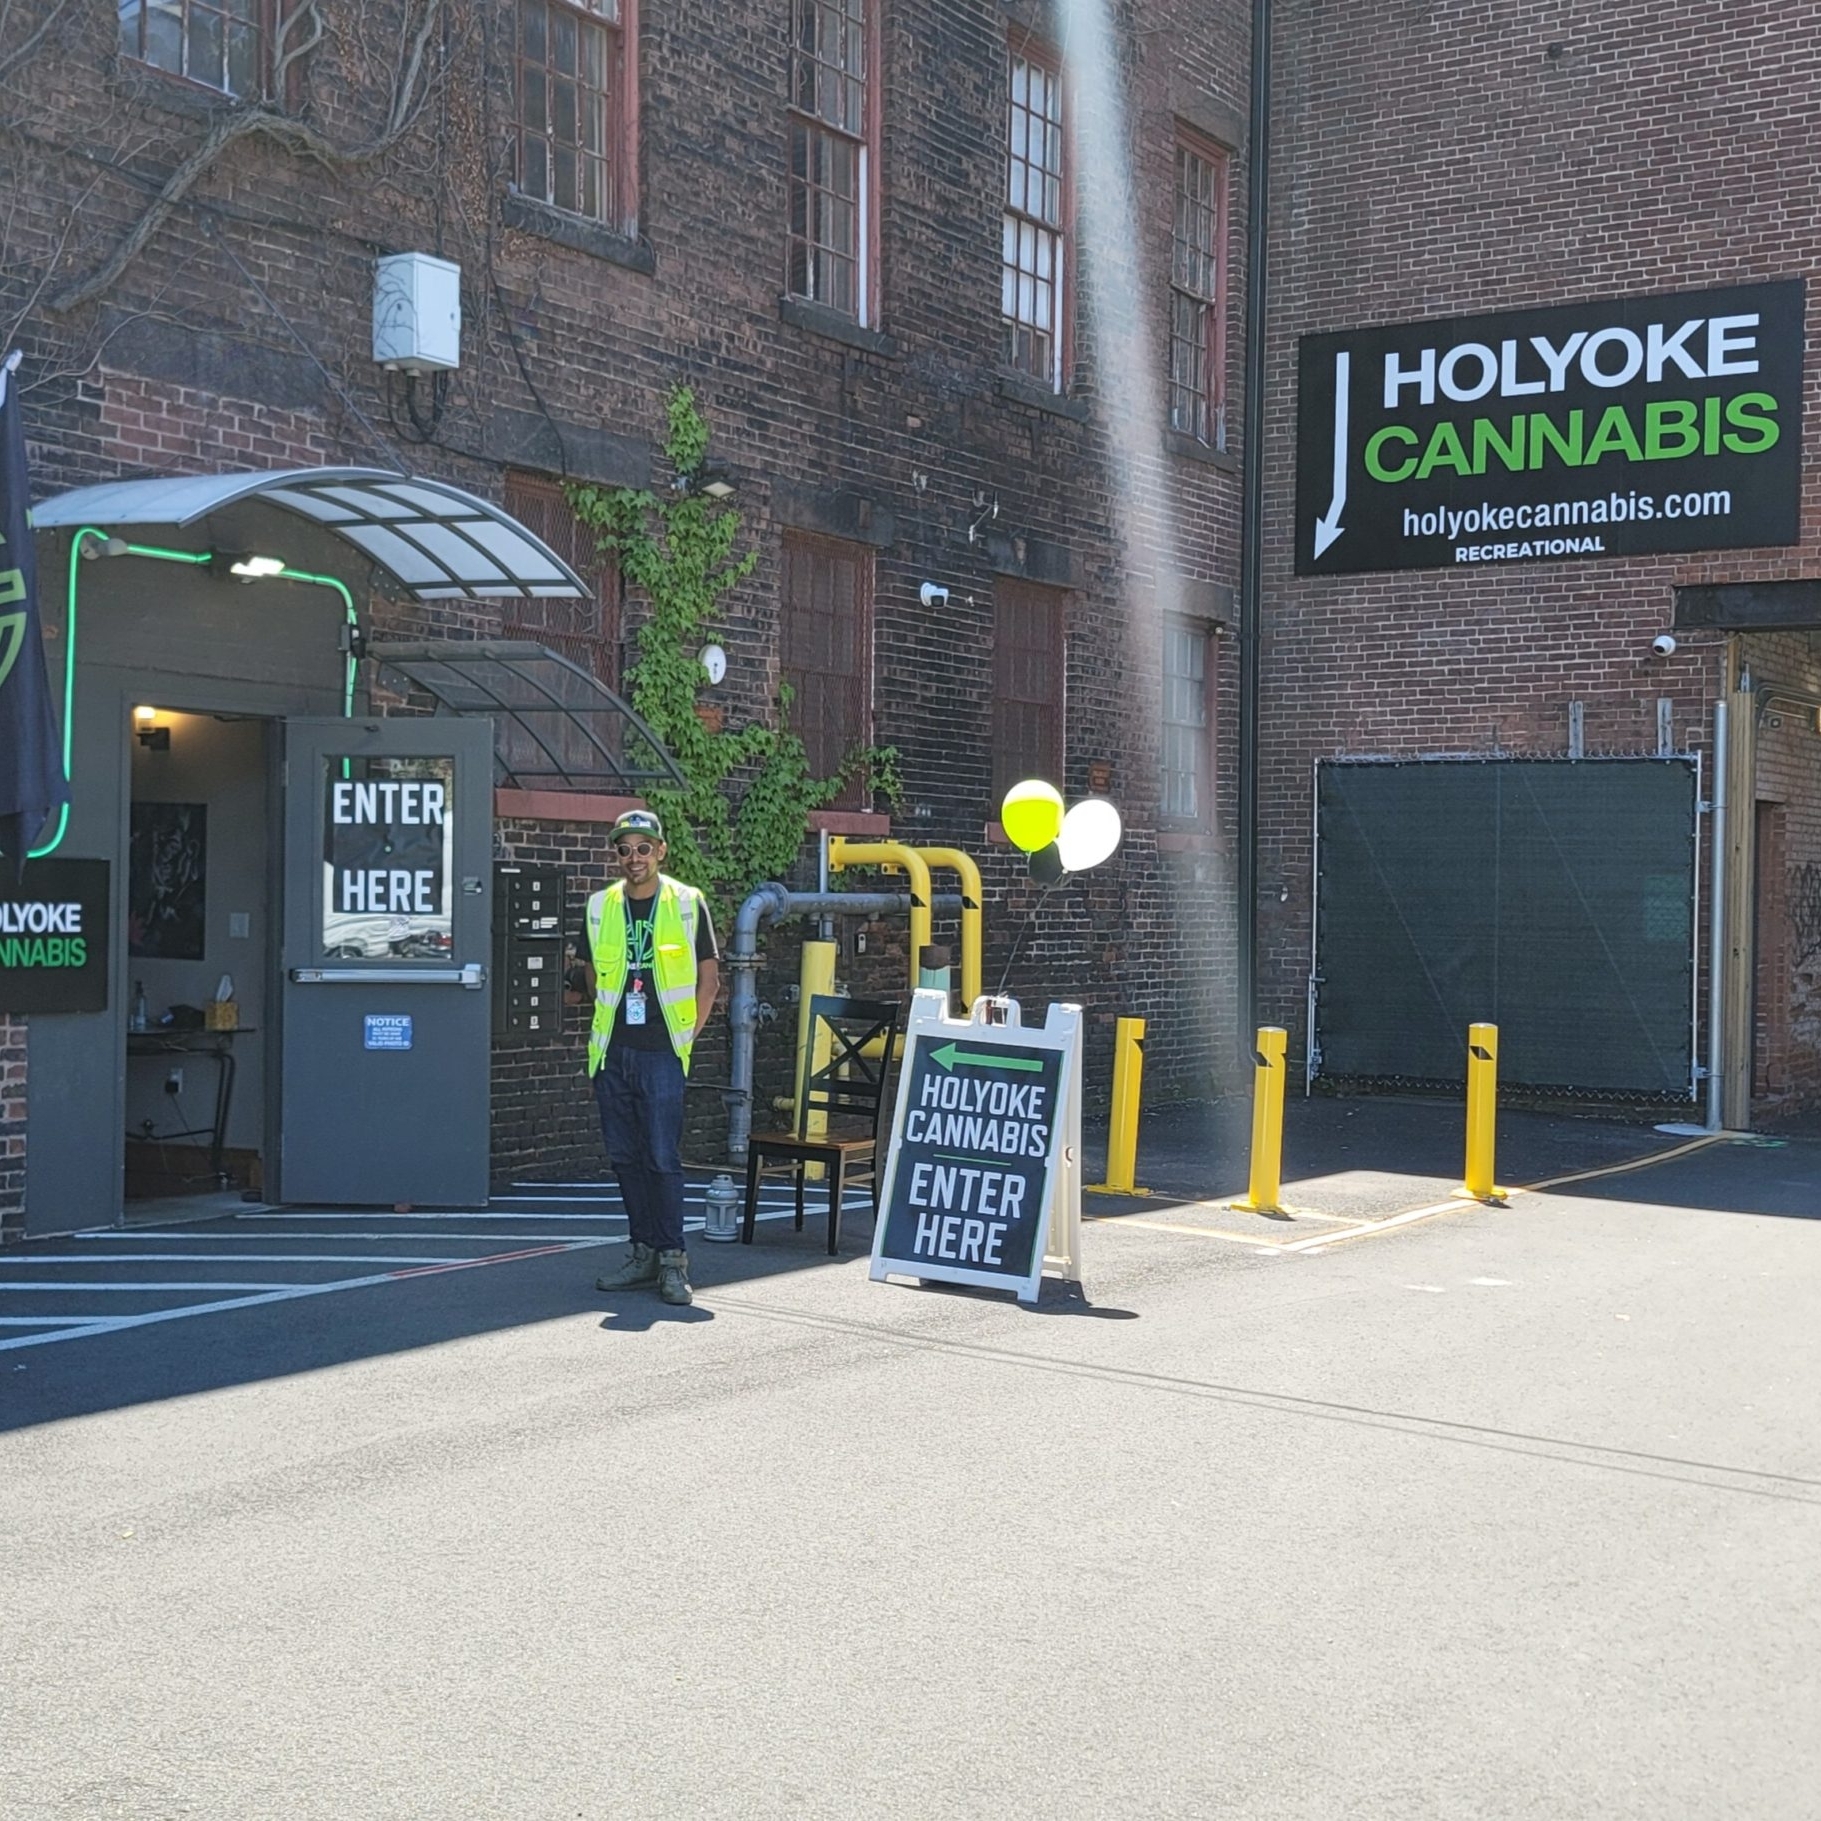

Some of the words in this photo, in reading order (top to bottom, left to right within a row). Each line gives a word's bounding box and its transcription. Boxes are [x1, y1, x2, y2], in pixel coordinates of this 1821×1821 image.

[1384, 313, 1760, 409] HOLYOKE
[1364, 391, 1781, 483] CANNABIS
[1403, 490, 1731, 540] holyokecannabis.com
[1455, 536, 1605, 563] RECREATIONAL
[333, 782, 444, 825] ENTER
[342, 869, 434, 912] HERE
[0, 902, 82, 933] LYOKE
[367, 1018, 410, 1027] NOTICE
[921, 1073, 1046, 1120] HOLYOKE
[906, 1109, 1048, 1158] CANNABIS
[908, 1162, 1026, 1219] ENTER
[913, 1212, 1008, 1266] HERE
